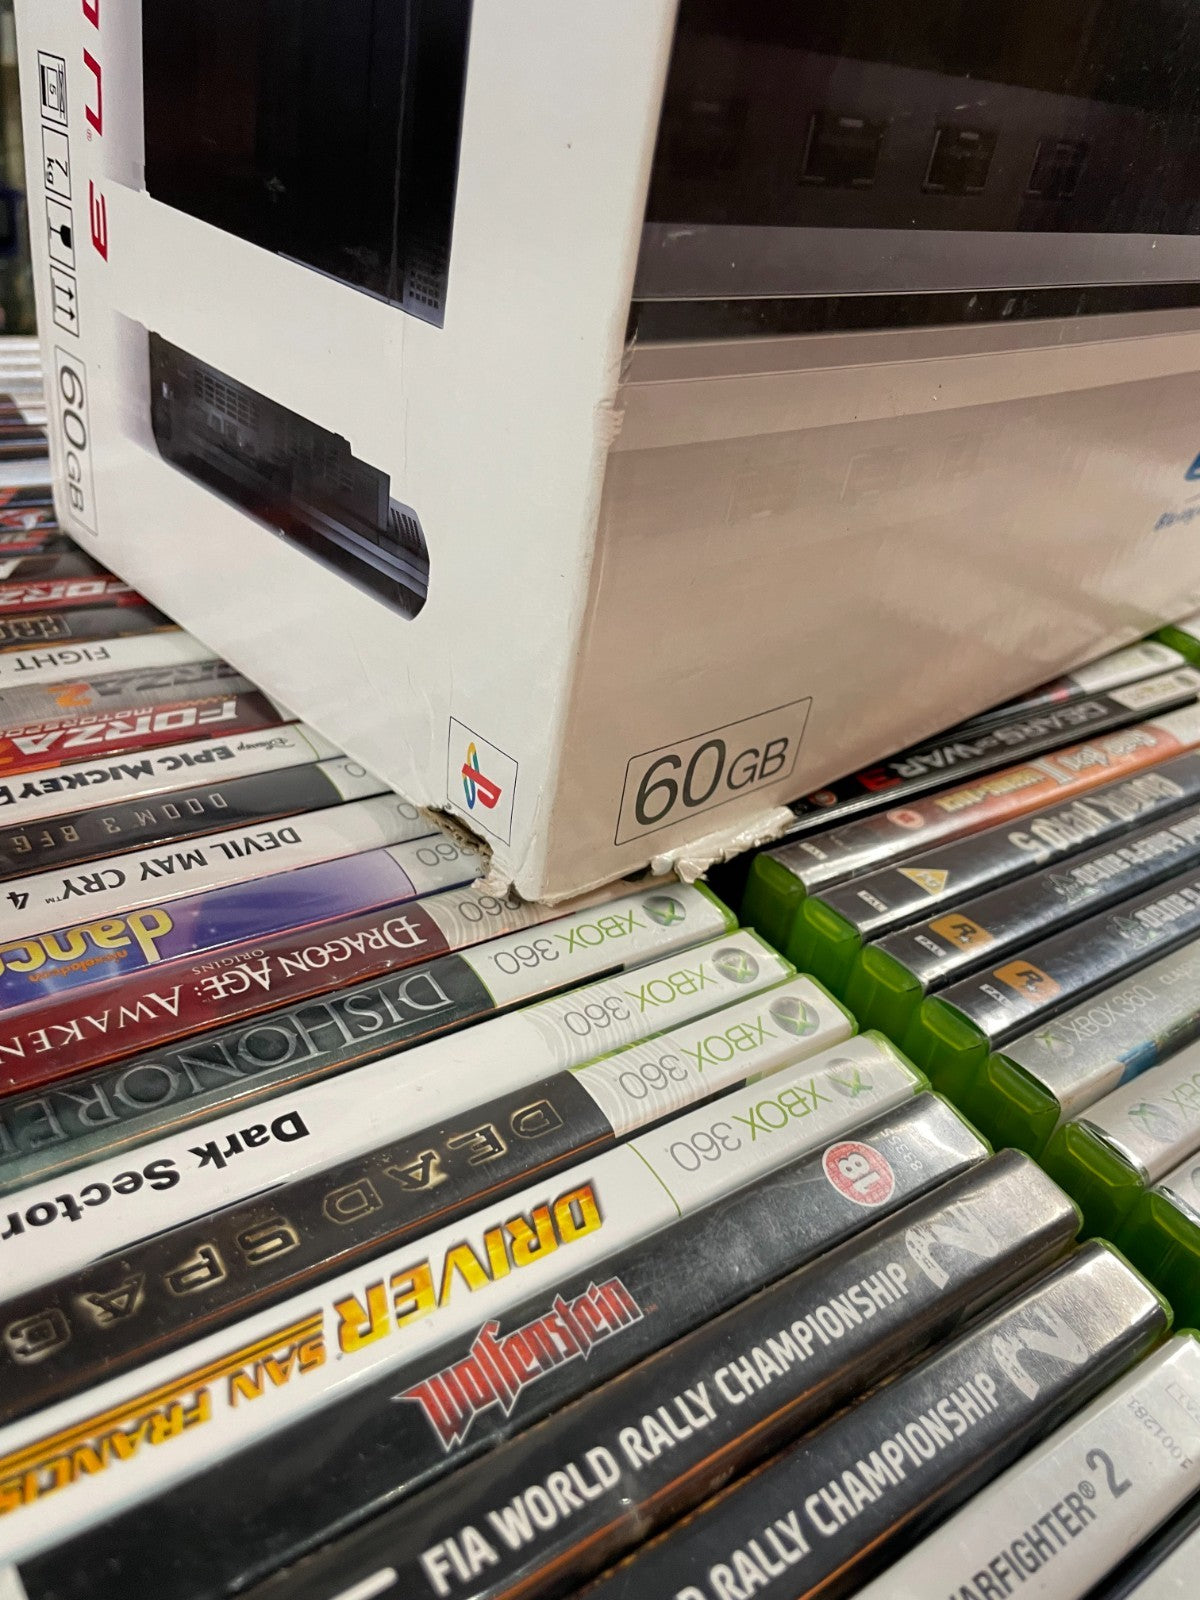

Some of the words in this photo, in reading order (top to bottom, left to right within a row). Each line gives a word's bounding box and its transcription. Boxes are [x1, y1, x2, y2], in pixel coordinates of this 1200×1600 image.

[89, 179, 109, 264] 3
[60, 364, 87, 514] 60GB
[14, 645, 112, 672] FIGHT
[46, 682, 94, 708] 2
[12, 698, 239, 757] FORZA
[237, 736, 296, 752] Disney
[18, 756, 156, 801] MICKEY
[156, 746, 237, 773] EPIC
[635, 736, 789, 826] 60GB
[896, 743, 985, 779] WAR
[101, 817, 123, 835] 3
[134, 791, 231, 829] DOOM
[10, 825, 82, 854] BFG
[140, 847, 210, 882] MAY
[209, 826, 304, 860] DEVIL
[6, 891, 30, 911] 4
[0, 907, 174, 978] danc
[281, 914, 429, 980] DRAGON
[553, 909, 648, 954] XBOX
[191, 948, 266, 976] ORIGINS
[624, 963, 719, 1013] XBOX
[562, 995, 632, 1037] 360
[1061, 1001, 1128, 1043] XBOX
[680, 1015, 779, 1073] XBOX
[617, 1054, 689, 1101] 360
[731, 1078, 834, 1142] XBOX
[186, 1109, 312, 1171] Dark
[321, 1098, 565, 1226] DEAD
[0, 1157, 183, 1241] Sector
[5, 1215, 302, 1364] SPAC
[333, 1179, 604, 1355] DRIVER
[226, 1332, 328, 1408] SAN
[418, 1523, 500, 1597] FIA
[486, 1444, 623, 1551] WORLD
[616, 1380, 720, 1469] RALLY
[713, 1261, 911, 1405] CHAMPIONSHIP
[708, 1509, 812, 1600] RALLY
[804, 1372, 999, 1538] CHAMPIONSHIP
[1084, 1446, 1134, 1500] 2
